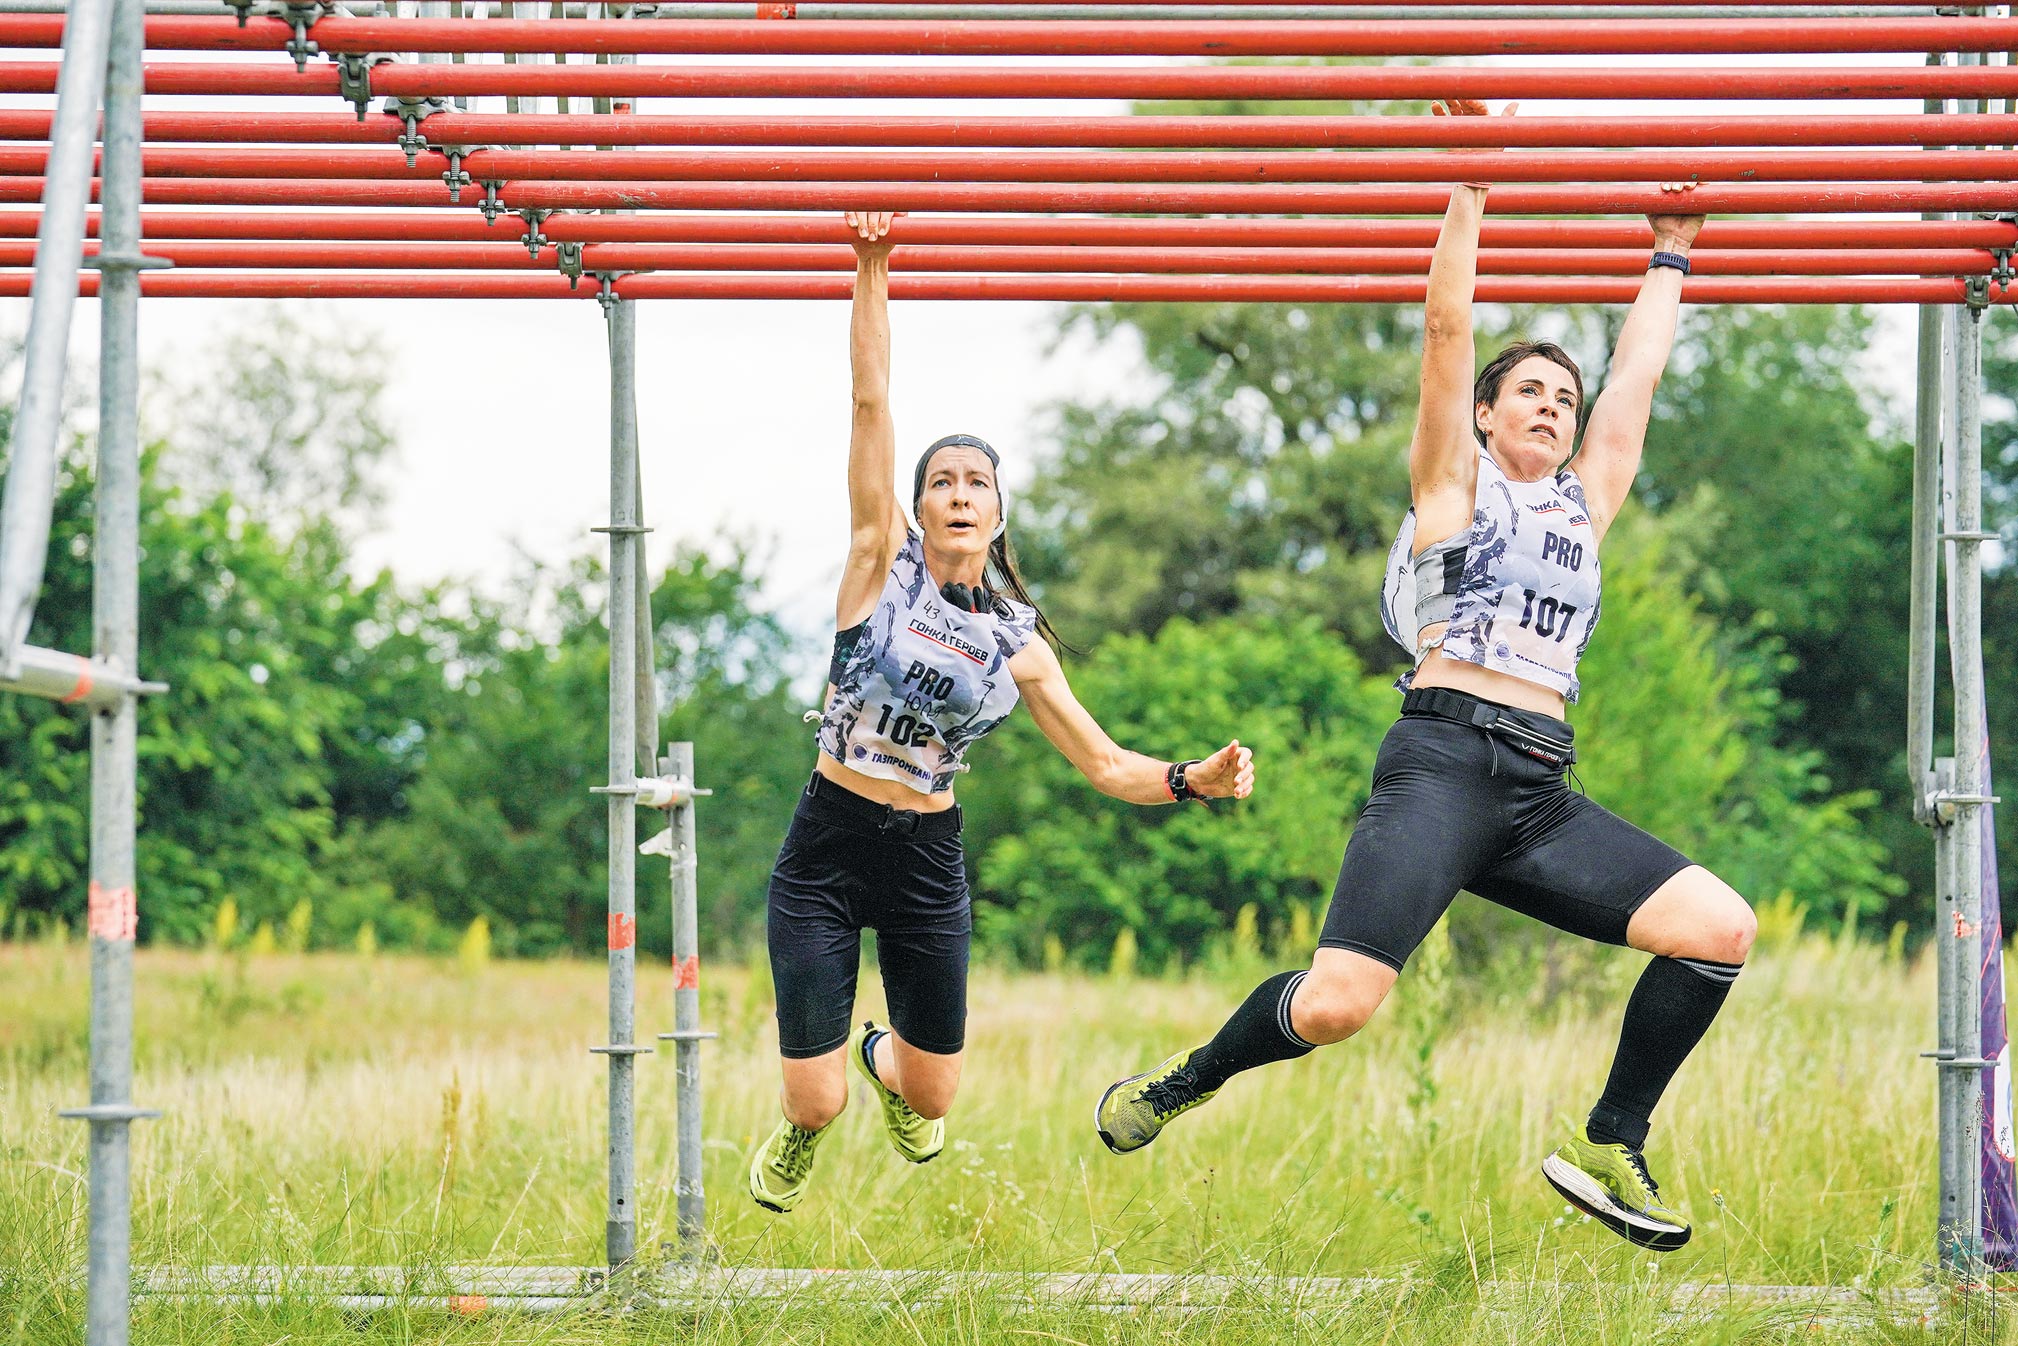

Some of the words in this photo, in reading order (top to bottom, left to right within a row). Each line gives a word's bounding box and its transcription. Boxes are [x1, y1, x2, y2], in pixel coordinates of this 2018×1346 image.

[1542, 531, 1583, 572] PRO
[923, 600, 941, 620] 43
[1519, 588, 1577, 643] 107
[909, 619, 947, 643] ГОНКА
[949, 636, 989, 662] ГЕРОЕВ
[902, 660, 955, 700] PRO
[876, 704, 936, 747] 102
